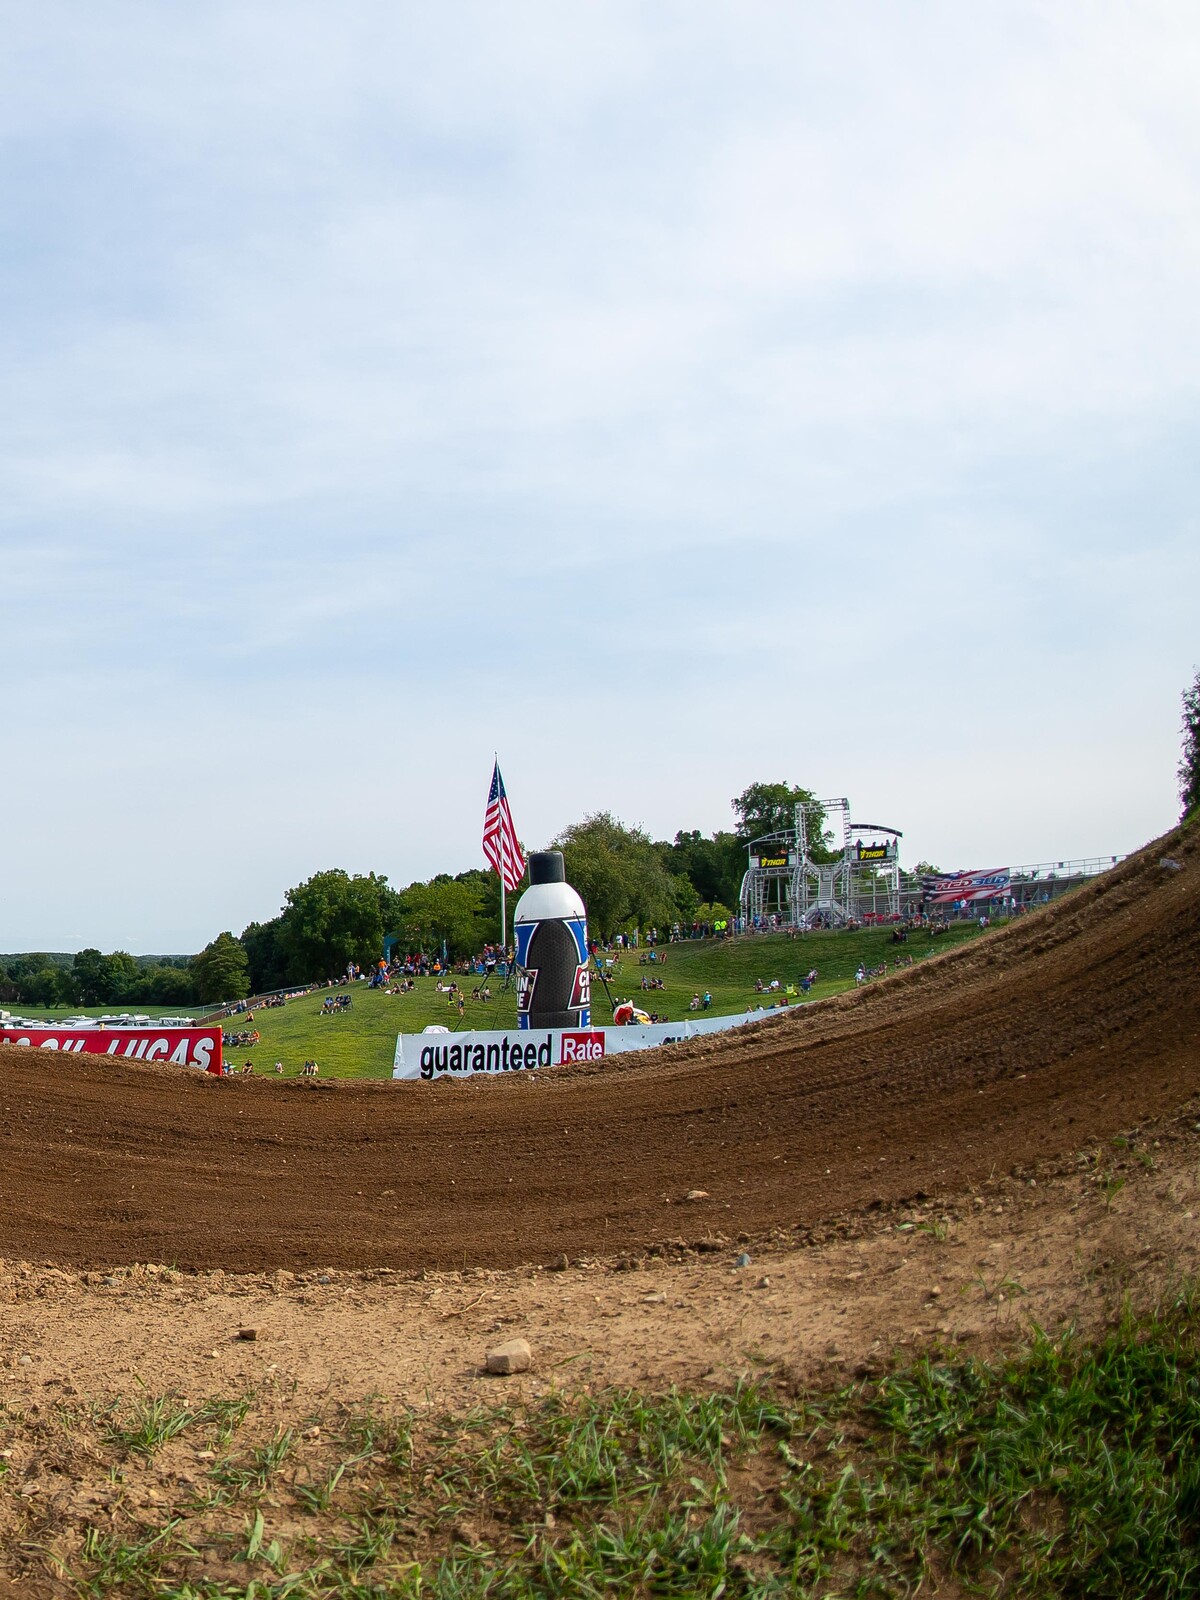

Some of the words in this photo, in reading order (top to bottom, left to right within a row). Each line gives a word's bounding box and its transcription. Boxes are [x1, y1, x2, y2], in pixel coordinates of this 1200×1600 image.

[865, 850, 885, 858] THOR
[767, 858, 786, 866] THOR
[420, 1034, 553, 1080] guaranteed
[563, 1038, 603, 1062] Rate
